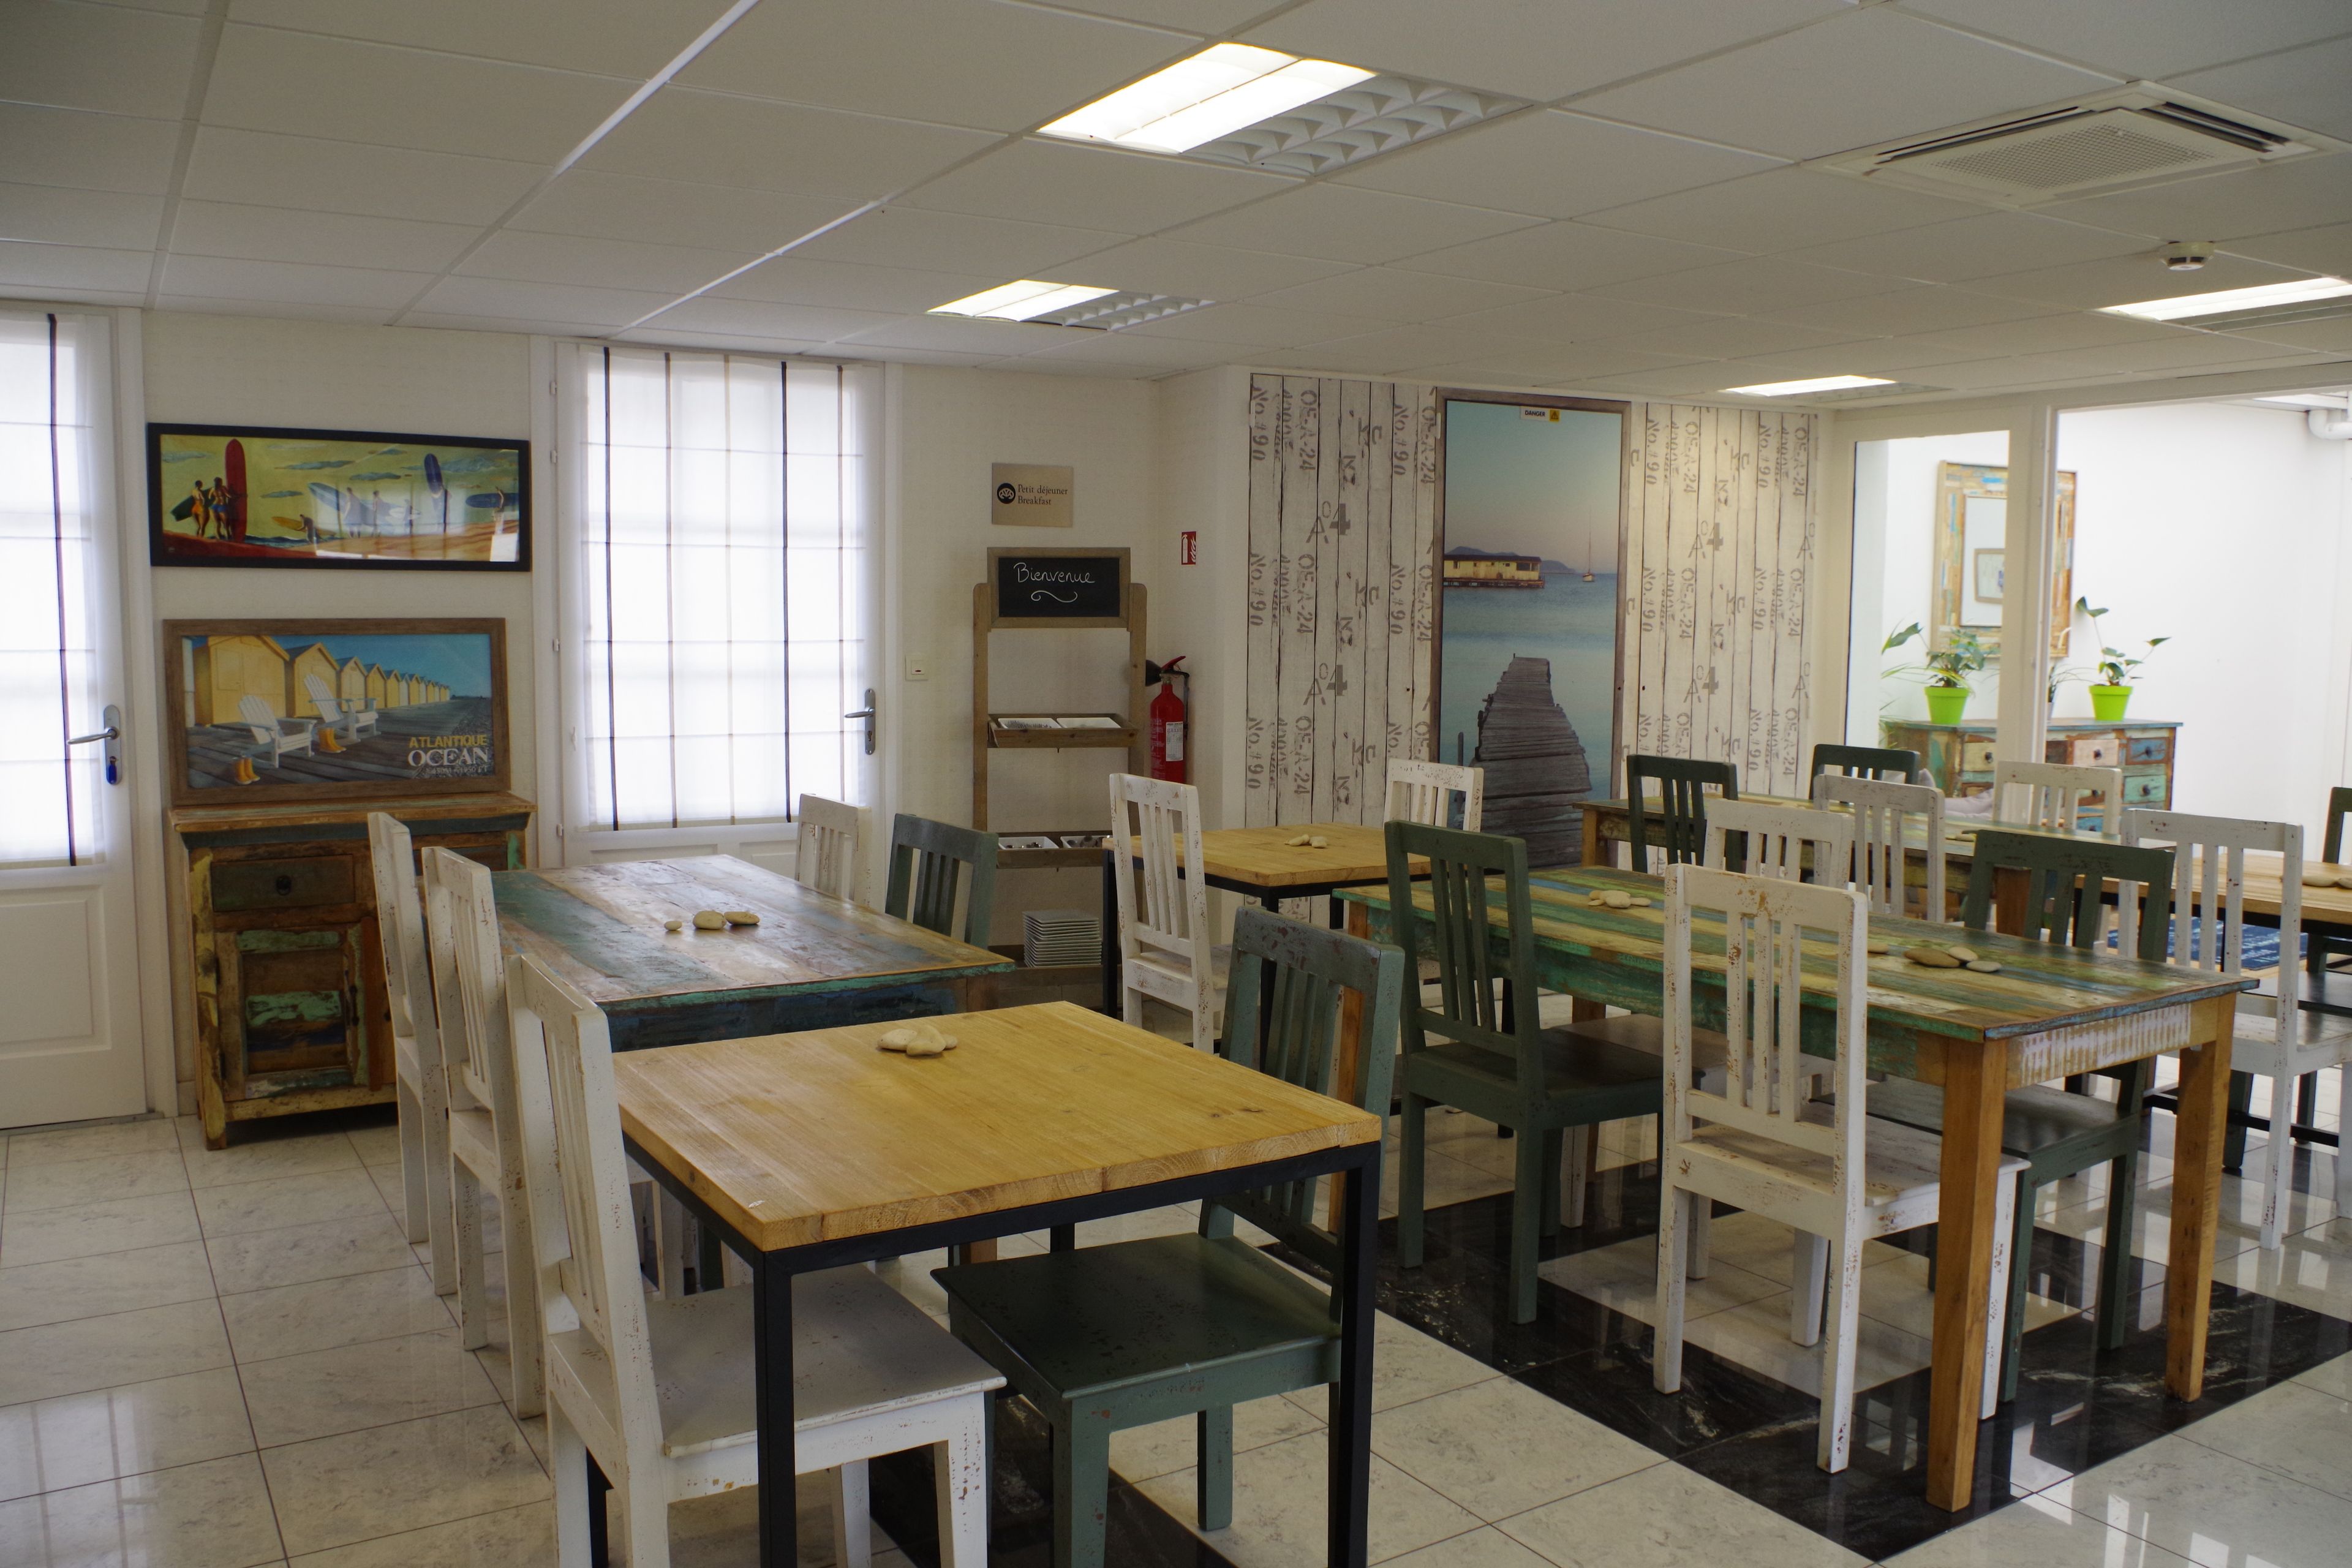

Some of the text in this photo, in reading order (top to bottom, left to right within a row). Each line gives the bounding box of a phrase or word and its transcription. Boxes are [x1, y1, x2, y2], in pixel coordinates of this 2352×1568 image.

[1252, 386, 1268, 461] No#90
[1018, 484, 1068, 496] Petit déjeuner
[1018, 496, 1051, 505] Breakfast
[1013, 562, 1095, 584] Bienvenue
[409, 734, 488, 748] ATLANTIQUE
[407, 747, 489, 767] OCEAN
